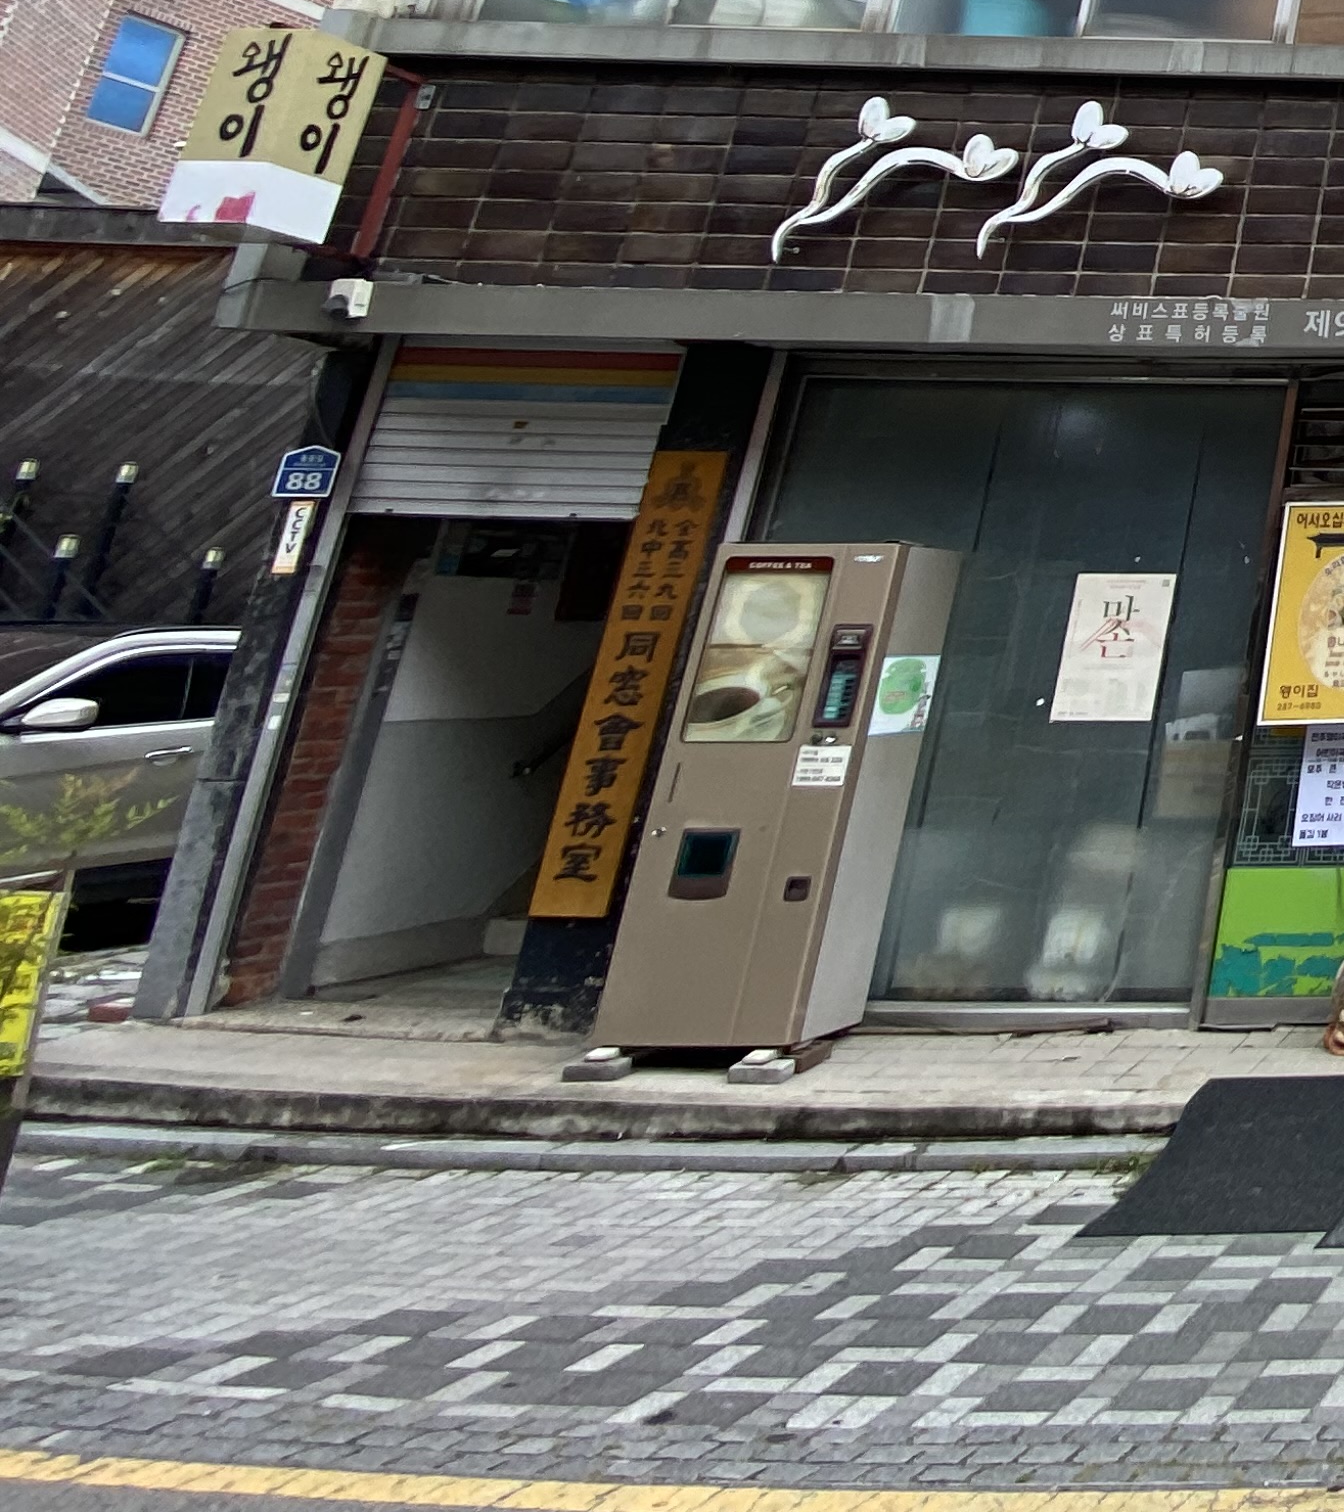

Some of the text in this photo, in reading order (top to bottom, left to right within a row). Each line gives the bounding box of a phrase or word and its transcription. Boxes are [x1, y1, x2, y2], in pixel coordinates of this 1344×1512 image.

[219, 33, 293, 158] 왱이
[300, 52, 370, 175] 왱이
[285, 471, 323, 491] 88
[285, 507, 307, 555] CCTV
